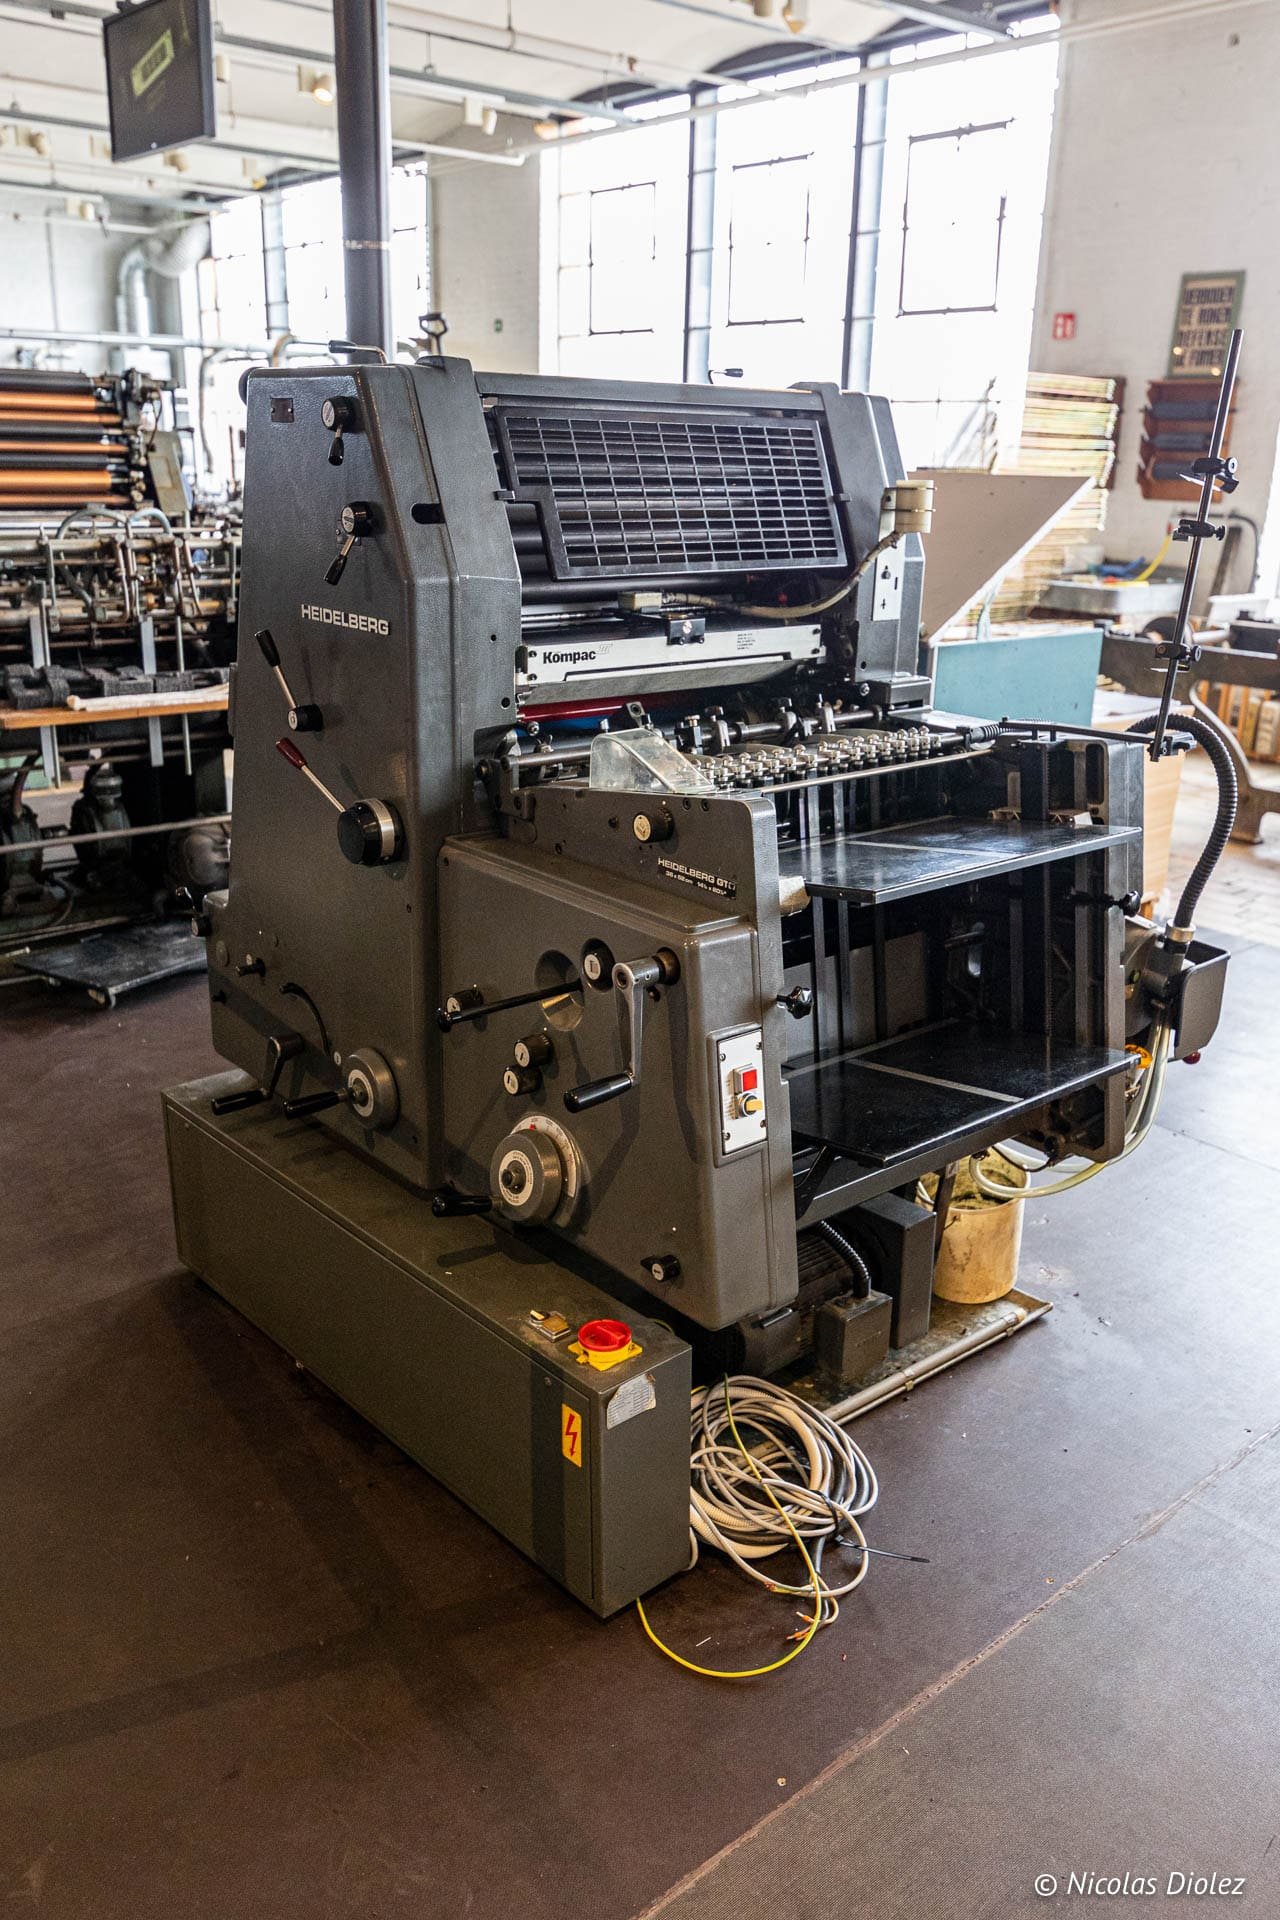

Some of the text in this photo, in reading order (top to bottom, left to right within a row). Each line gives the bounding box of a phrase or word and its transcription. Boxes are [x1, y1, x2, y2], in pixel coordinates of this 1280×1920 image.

[300, 603, 389, 636] HEIDELBERG
[543, 650, 597, 664] Kompac
[657, 856, 736, 891] HEIDELBERG GTO
